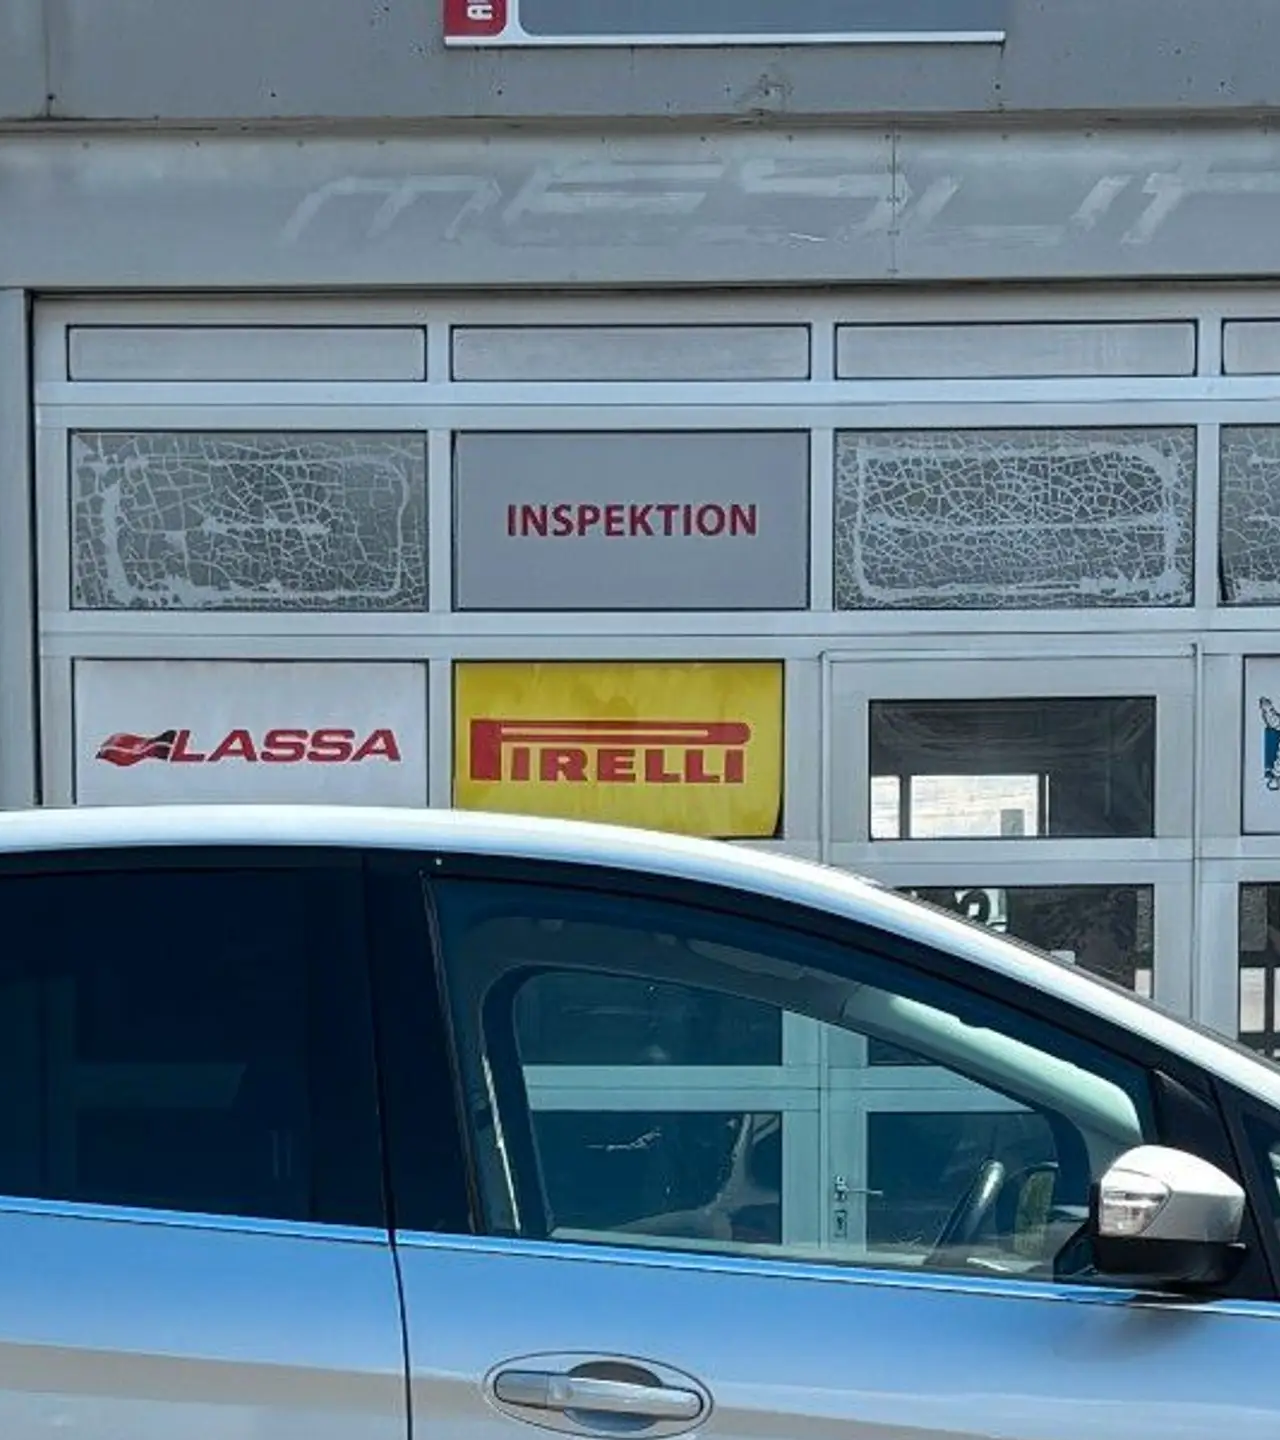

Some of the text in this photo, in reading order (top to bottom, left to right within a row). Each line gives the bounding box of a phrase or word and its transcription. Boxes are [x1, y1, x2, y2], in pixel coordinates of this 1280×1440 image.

[505, 503, 757, 537] INSPEKTION
[170, 727, 402, 764] LASSA
[470, 720, 751, 784] PIRELLI
